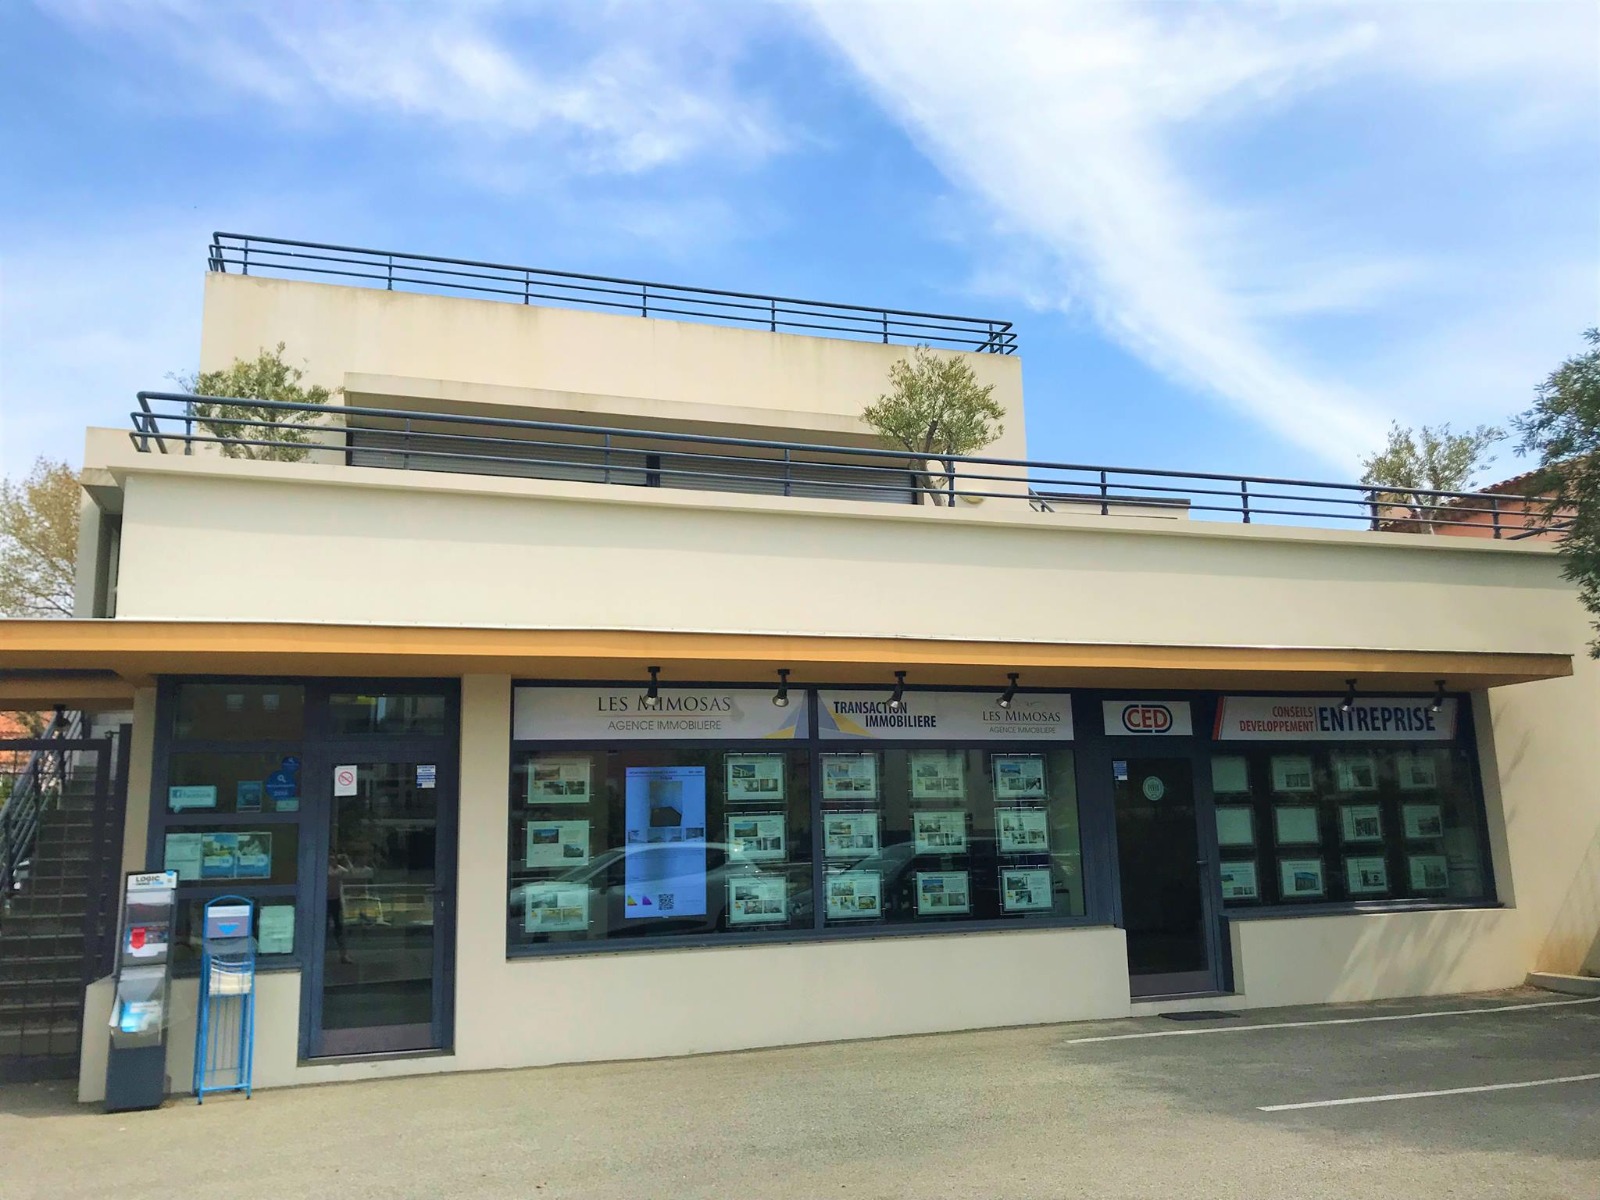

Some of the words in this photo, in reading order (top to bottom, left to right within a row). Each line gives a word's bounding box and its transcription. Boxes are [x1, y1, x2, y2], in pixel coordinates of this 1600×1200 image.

[598, 696, 628, 712] LES
[637, 695, 731, 712] MIMOSAS
[982, 711, 1001, 722] LES
[1005, 710, 1061, 723] MIMOSAS
[1127, 708, 1168, 729] CED
[1272, 706, 1314, 718] CONSEILS
[608, 720, 654, 731] AGENCE
[657, 720, 722, 731] IMMOBILIERE
[865, 714, 937, 728] IMMOBILIERE
[1319, 706, 1436, 732] ENTREPRISE
[989, 726, 1017, 734] AGENCE
[1019, 726, 1056, 734] IMMOBILIERE
[1239, 720, 1315, 733] DEVELOPPEMENT
[136, 875, 161, 883] LOGIC
